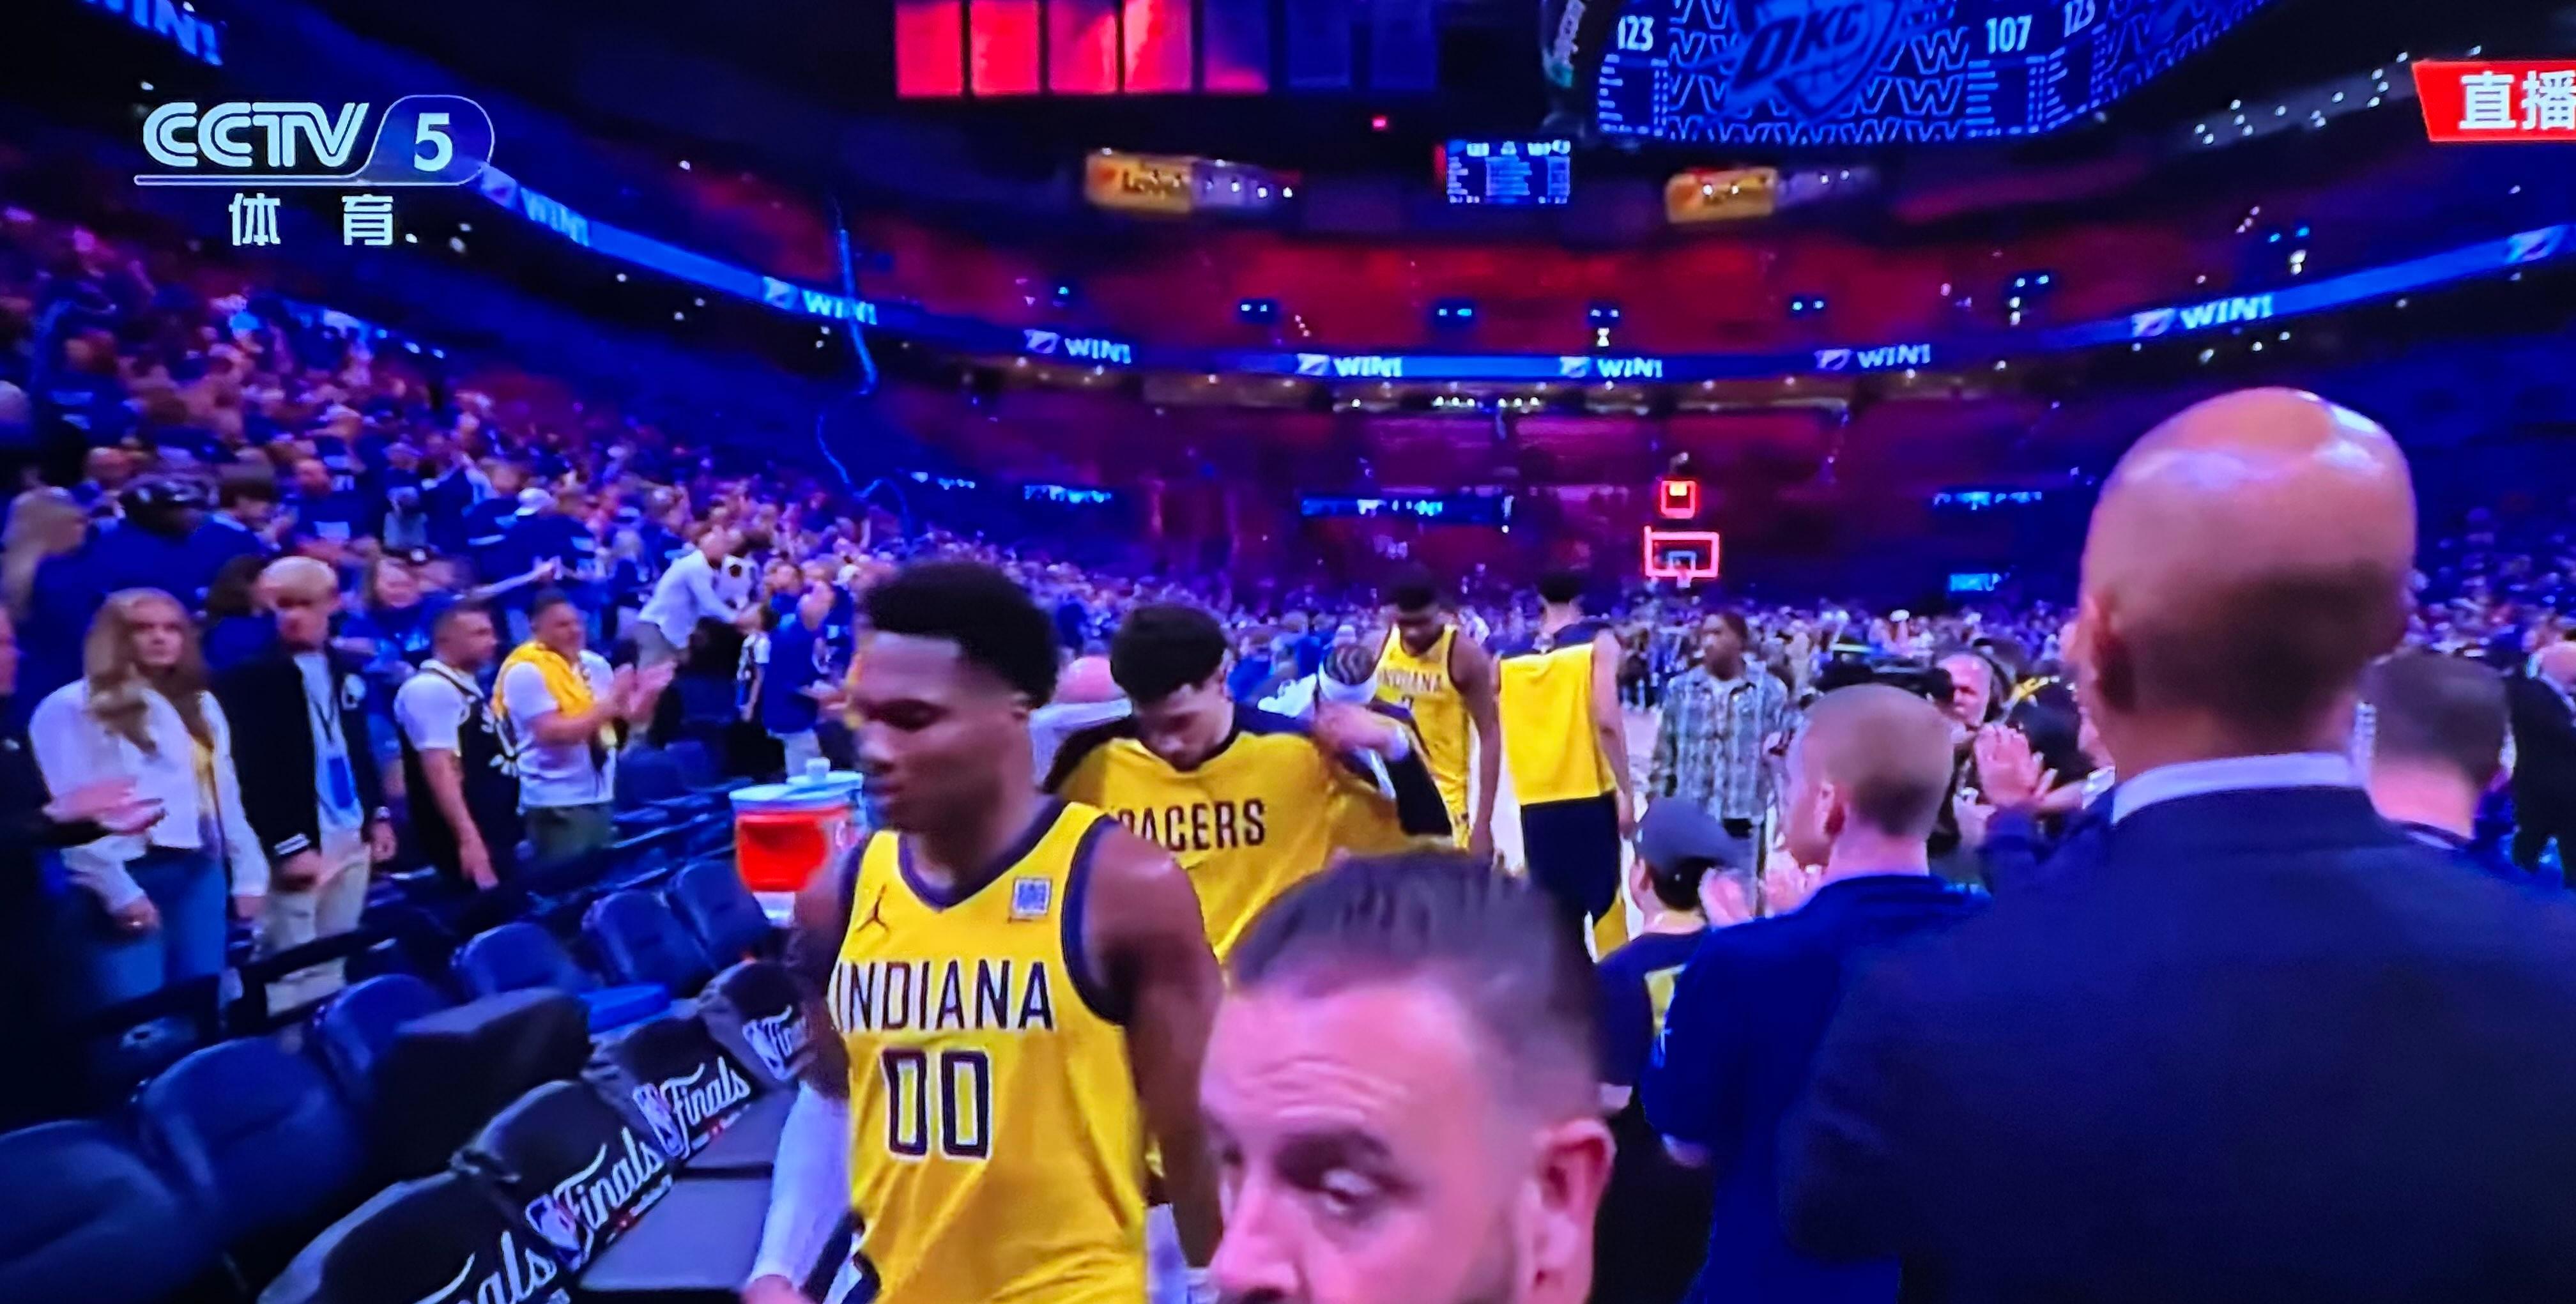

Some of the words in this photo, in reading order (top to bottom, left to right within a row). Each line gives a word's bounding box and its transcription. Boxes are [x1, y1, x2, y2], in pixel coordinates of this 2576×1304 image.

[1618, 16, 1653, 51] 123
[1986, 14, 2032, 54] 107
[2459, 70, 2576, 130] 直播
[142, 102, 369, 167] CCTV
[414, 112, 453, 172] 5
[229, 193, 394, 246] 体育
[826, 957, 1057, 1032] INDIANA
[659, 1055, 751, 1159] Finals
[879, 1047, 992, 1160] 00
[553, 1126, 664, 1262] Finals
